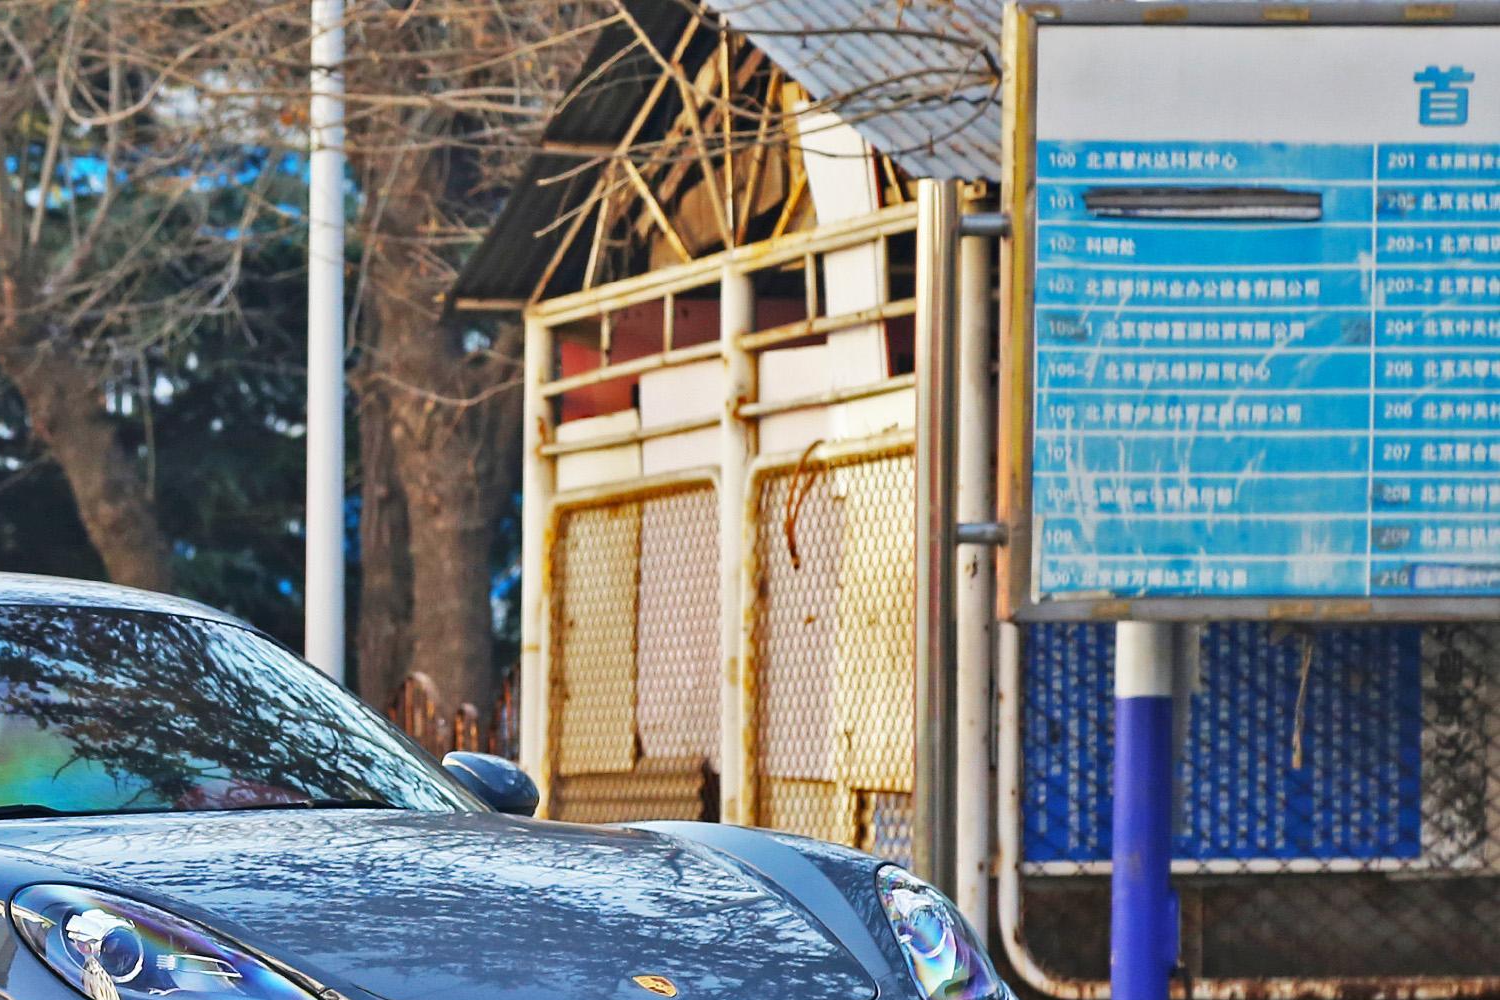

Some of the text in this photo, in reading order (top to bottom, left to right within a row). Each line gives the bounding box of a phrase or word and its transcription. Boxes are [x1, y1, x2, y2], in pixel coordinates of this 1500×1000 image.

[1414, 64, 1475, 126] 首
[1049, 152, 1076, 168] 100
[1388, 153, 1415, 169] 201
[1049, 195, 1075, 209] 101
[1385, 319, 1413, 335] 204
[1385, 361, 1413, 376] 205
[1383, 443, 1411, 460] 207
